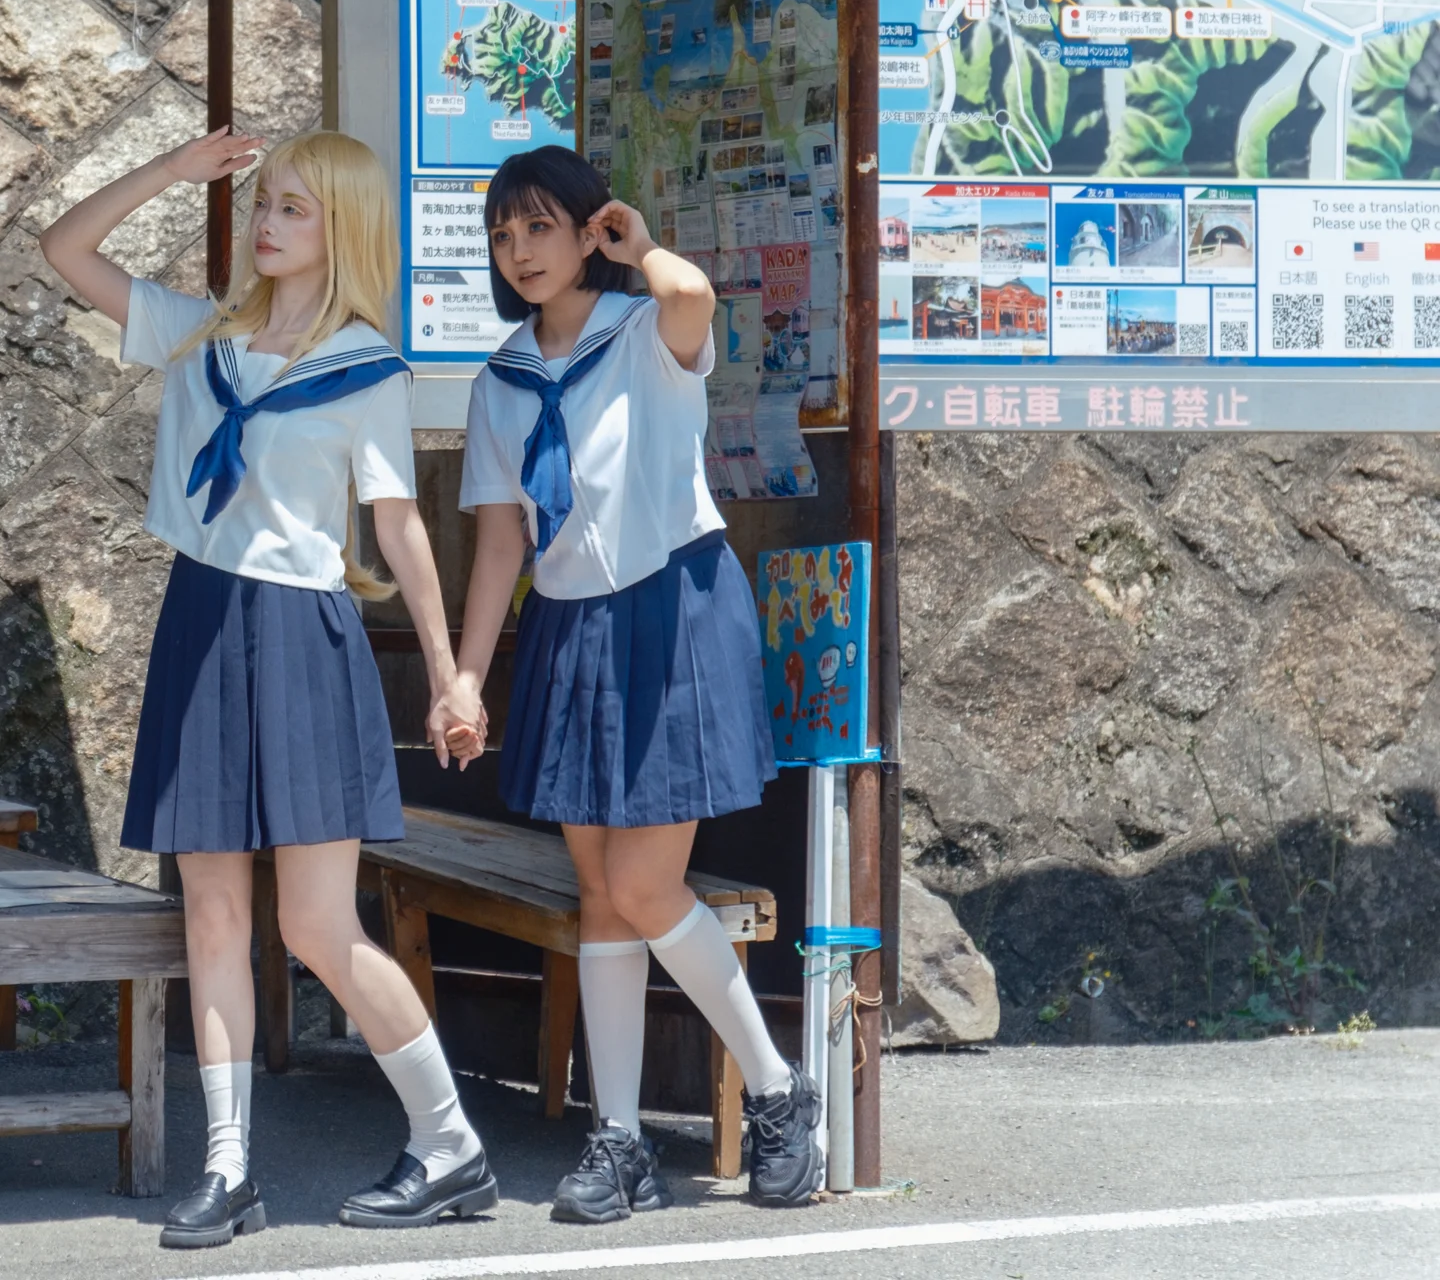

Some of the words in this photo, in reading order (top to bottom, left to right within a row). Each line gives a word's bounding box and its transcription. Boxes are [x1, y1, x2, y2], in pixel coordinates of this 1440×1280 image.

[765, 246, 807, 270] KADA
[442, 293, 490, 303] 観光案内所
[1087, 386, 1251, 428] 駐輪禁止
